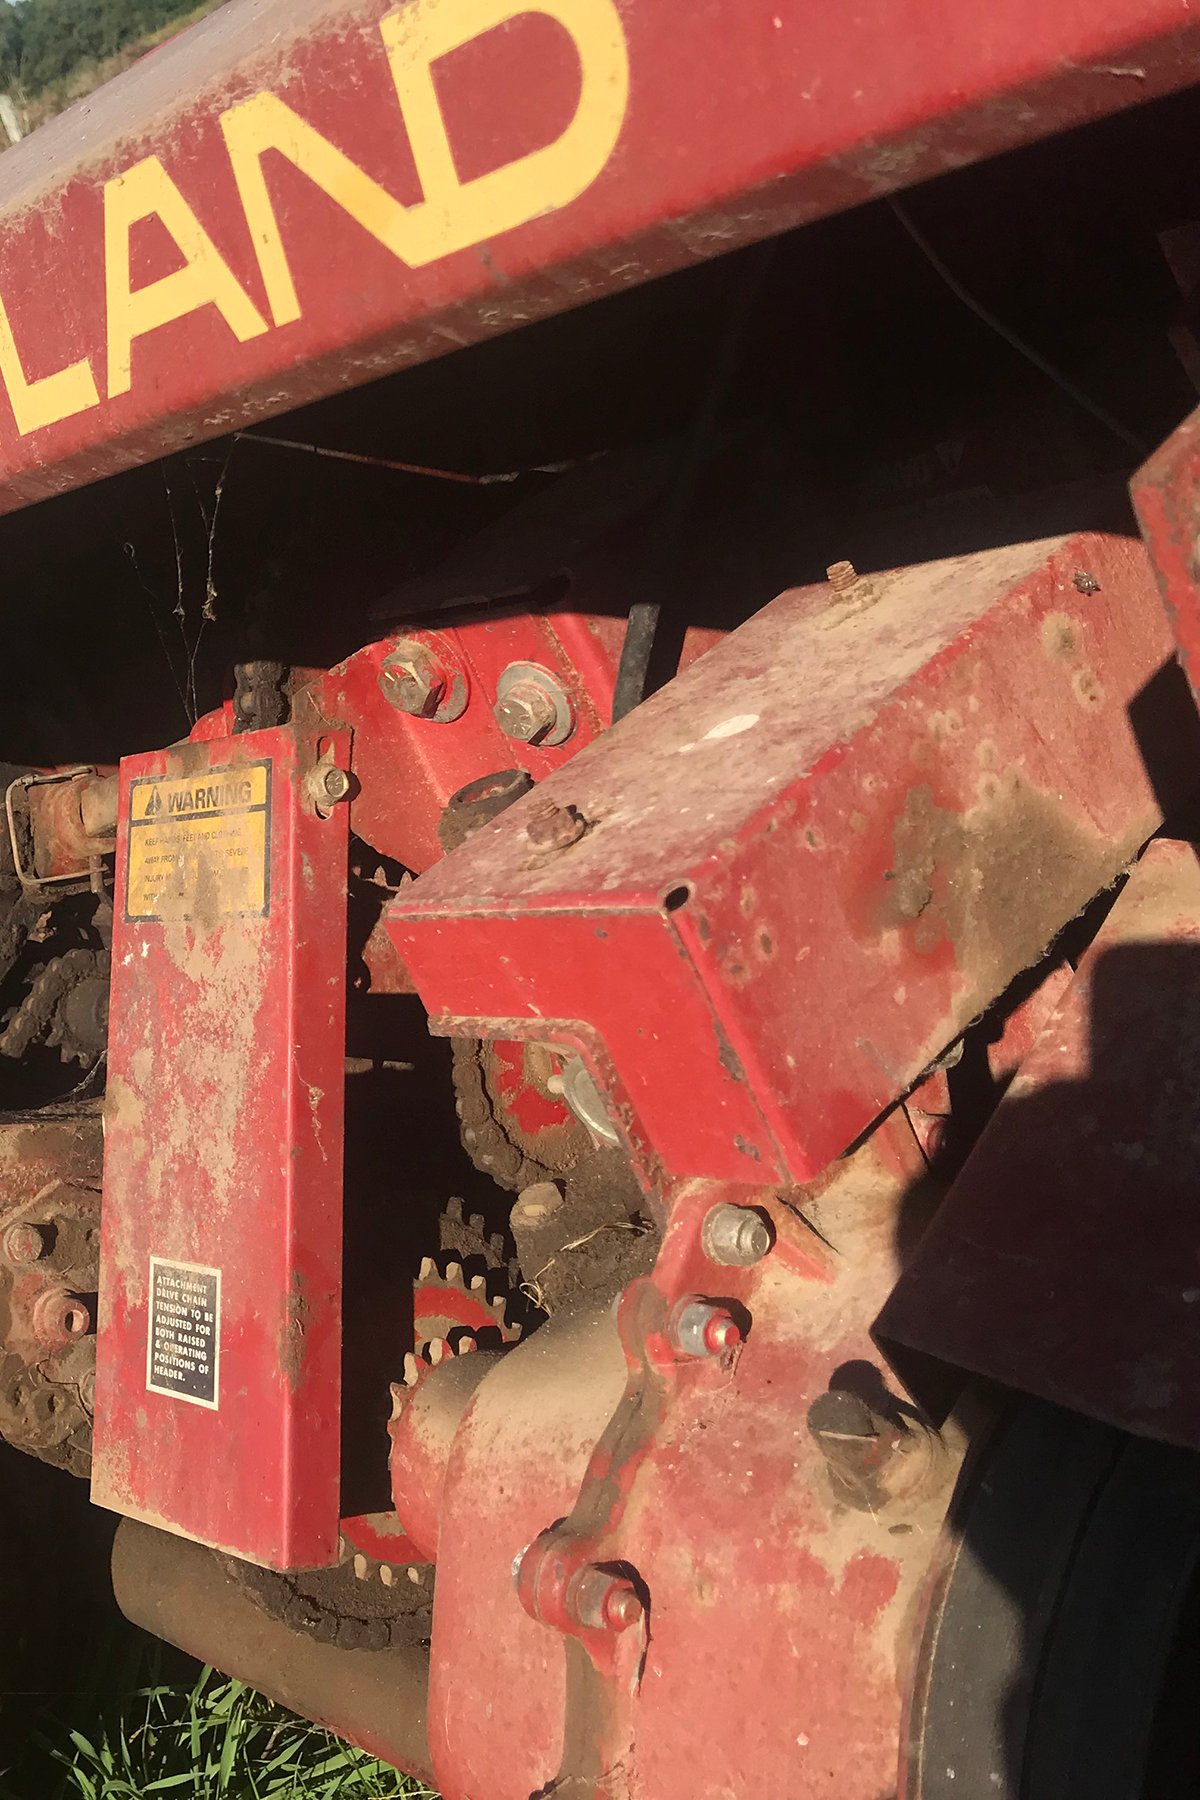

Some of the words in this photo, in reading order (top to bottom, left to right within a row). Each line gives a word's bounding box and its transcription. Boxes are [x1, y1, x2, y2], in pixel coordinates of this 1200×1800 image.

[168, 781, 252, 813] WARNING
[156, 1275, 208, 1295] ATTACHMENT
[156, 1286, 179, 1301] DRIVE
[181, 1293, 208, 1308] CHAIN
[155, 1300, 188, 1317] TENSION
[191, 1308, 201, 1320] TO
[204, 1311, 214, 1323] BE
[155, 1313, 192, 1332] ADJUSTED
[195, 1323, 211, 1337] FOR
[154, 1340, 161, 1350] &
[155, 1326, 175, 1341] BOTH
[177, 1332, 206, 1348] RAISED
[153, 1364, 186, 1382] HEADER.
[154, 1351, 196, 1372] POSITIONS
[198, 1362, 210, 1375] OF
